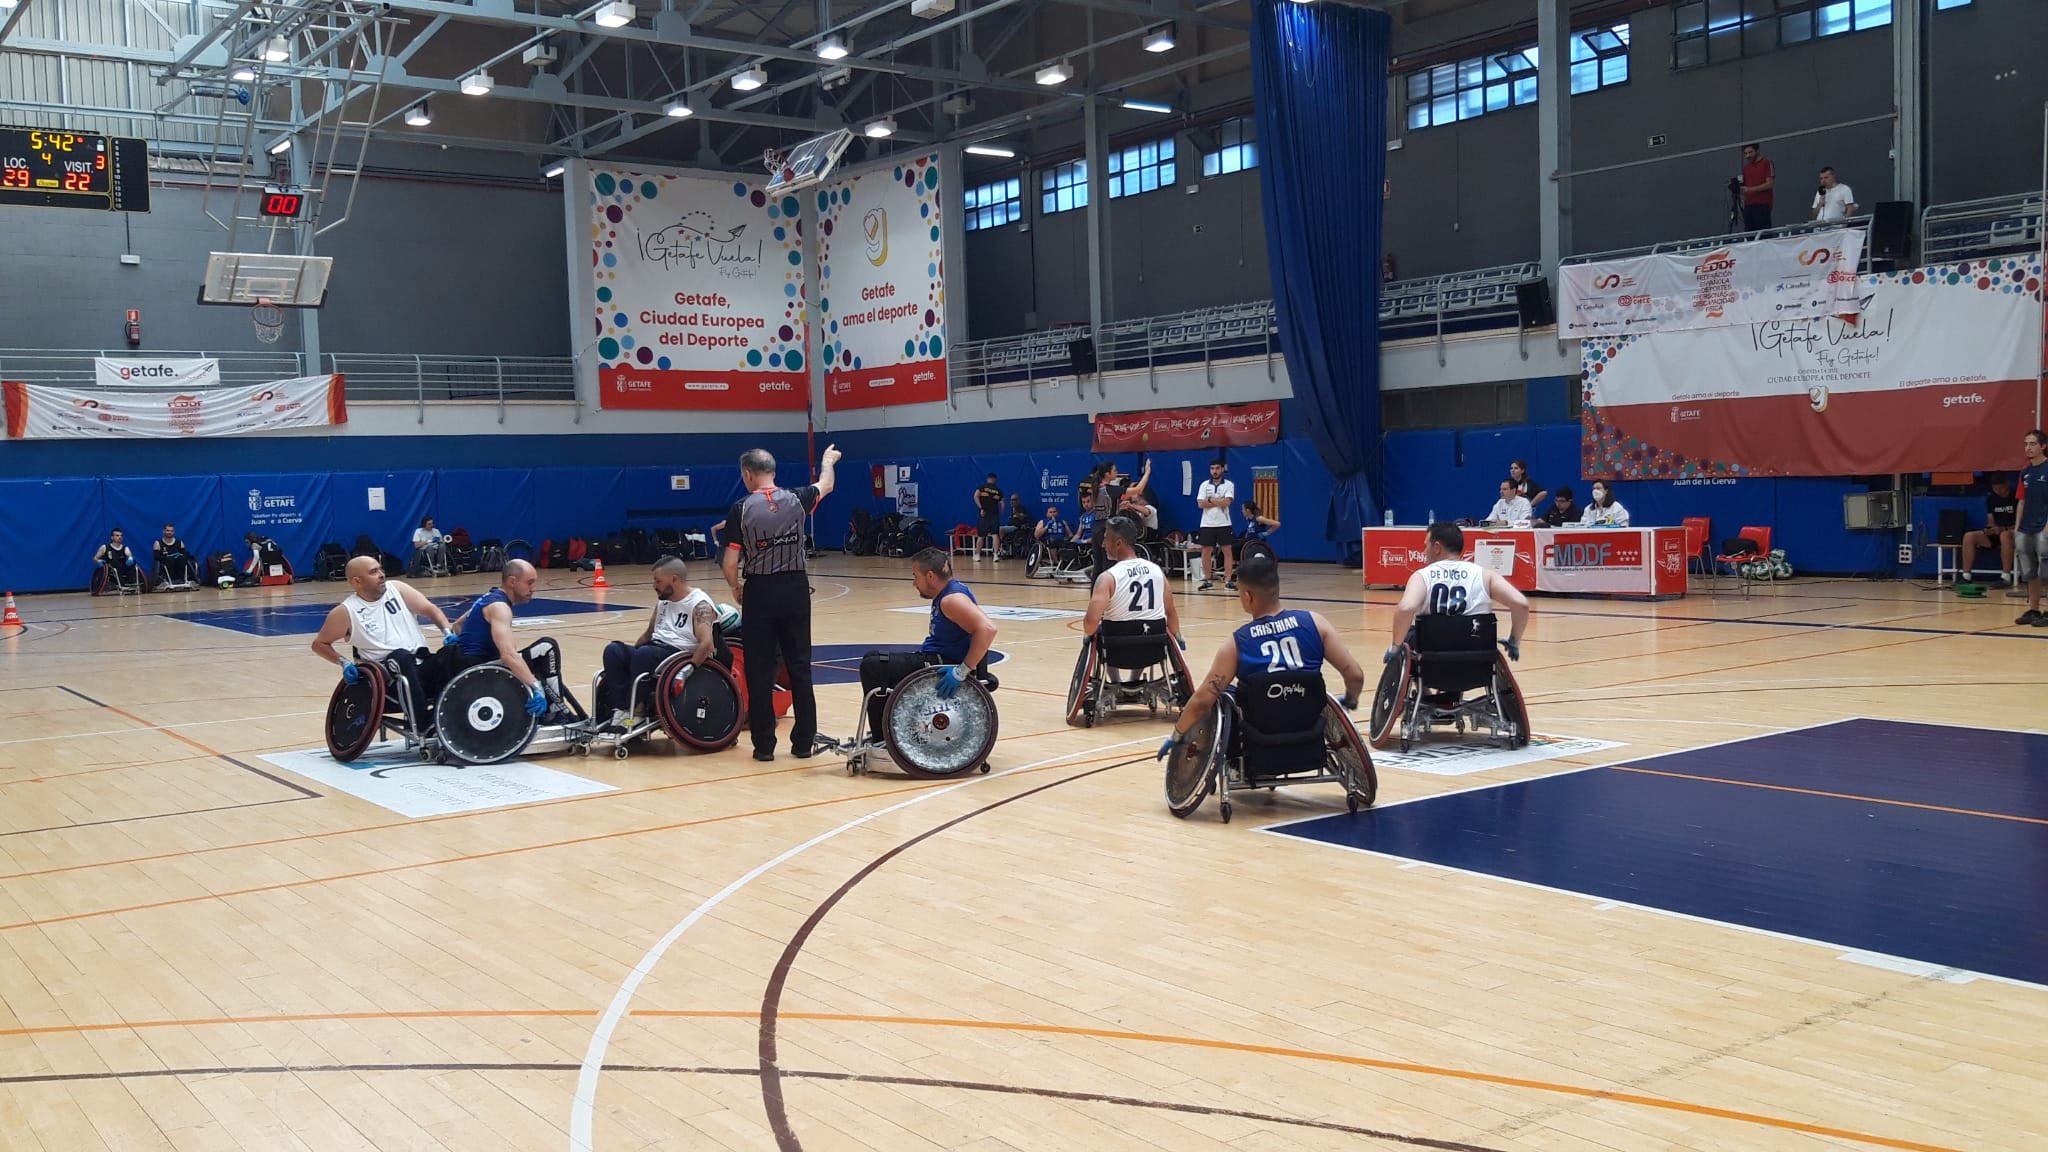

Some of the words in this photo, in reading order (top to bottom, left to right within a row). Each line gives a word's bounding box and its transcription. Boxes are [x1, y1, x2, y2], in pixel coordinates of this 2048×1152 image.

[31, 132, 74, 151] 5:42
[3, 157, 29, 169] LOC.
[41, 152, 52, 165] 4
[64, 161, 94, 173] VISIT.
[96, 155, 105, 170] 3
[3, 169, 29, 187] 29
[65, 173, 91, 190] 22
[267, 195, 299, 214] 00
[707, 239, 763, 268] Vuela!
[861, 282, 896, 301] Getafe
[674, 292, 731, 309] Getafe,
[640, 310, 698, 326] Ciudad
[702, 313, 765, 331] Europea
[842, 313, 865, 327] ama
[867, 308, 876, 322] el
[877, 302, 918, 324] deporte
[1827, 307, 1894, 346] Vuela!
[659, 332, 683, 345] del
[687, 332, 749, 350] Deporte
[1815, 349, 1836, 366] Fly
[1838, 346, 1880, 367] Getafe!
[120, 364, 179, 380] getafe.
[912, 370, 936, 385] getafe.
[1767, 375, 1793, 384] CIUDAD
[1793, 374, 1825, 382] EUROPEA
[1826, 373, 1838, 381] DEL
[1840, 371, 1872, 380] DEPORTE
[759, 382, 795, 393] getafe.
[1943, 393, 1985, 408] getafe.
[1049, 479, 1069, 487] GETAFE
[1692, 478, 1703, 486] de
[1703, 477, 1711, 485] la
[264, 499, 296, 508] GETAFE
[1543, 543, 1612, 566] FMDDF
[1127, 566, 1150, 578] DAVID
[1430, 570, 1441, 579] DE
[1128, 579, 1154, 612] 21
[1430, 583, 1467, 616] 08
[675, 612, 688, 628] 13
[1250, 616, 1299, 638] CRISTHIAN
[1260, 636, 1304, 673] 20
